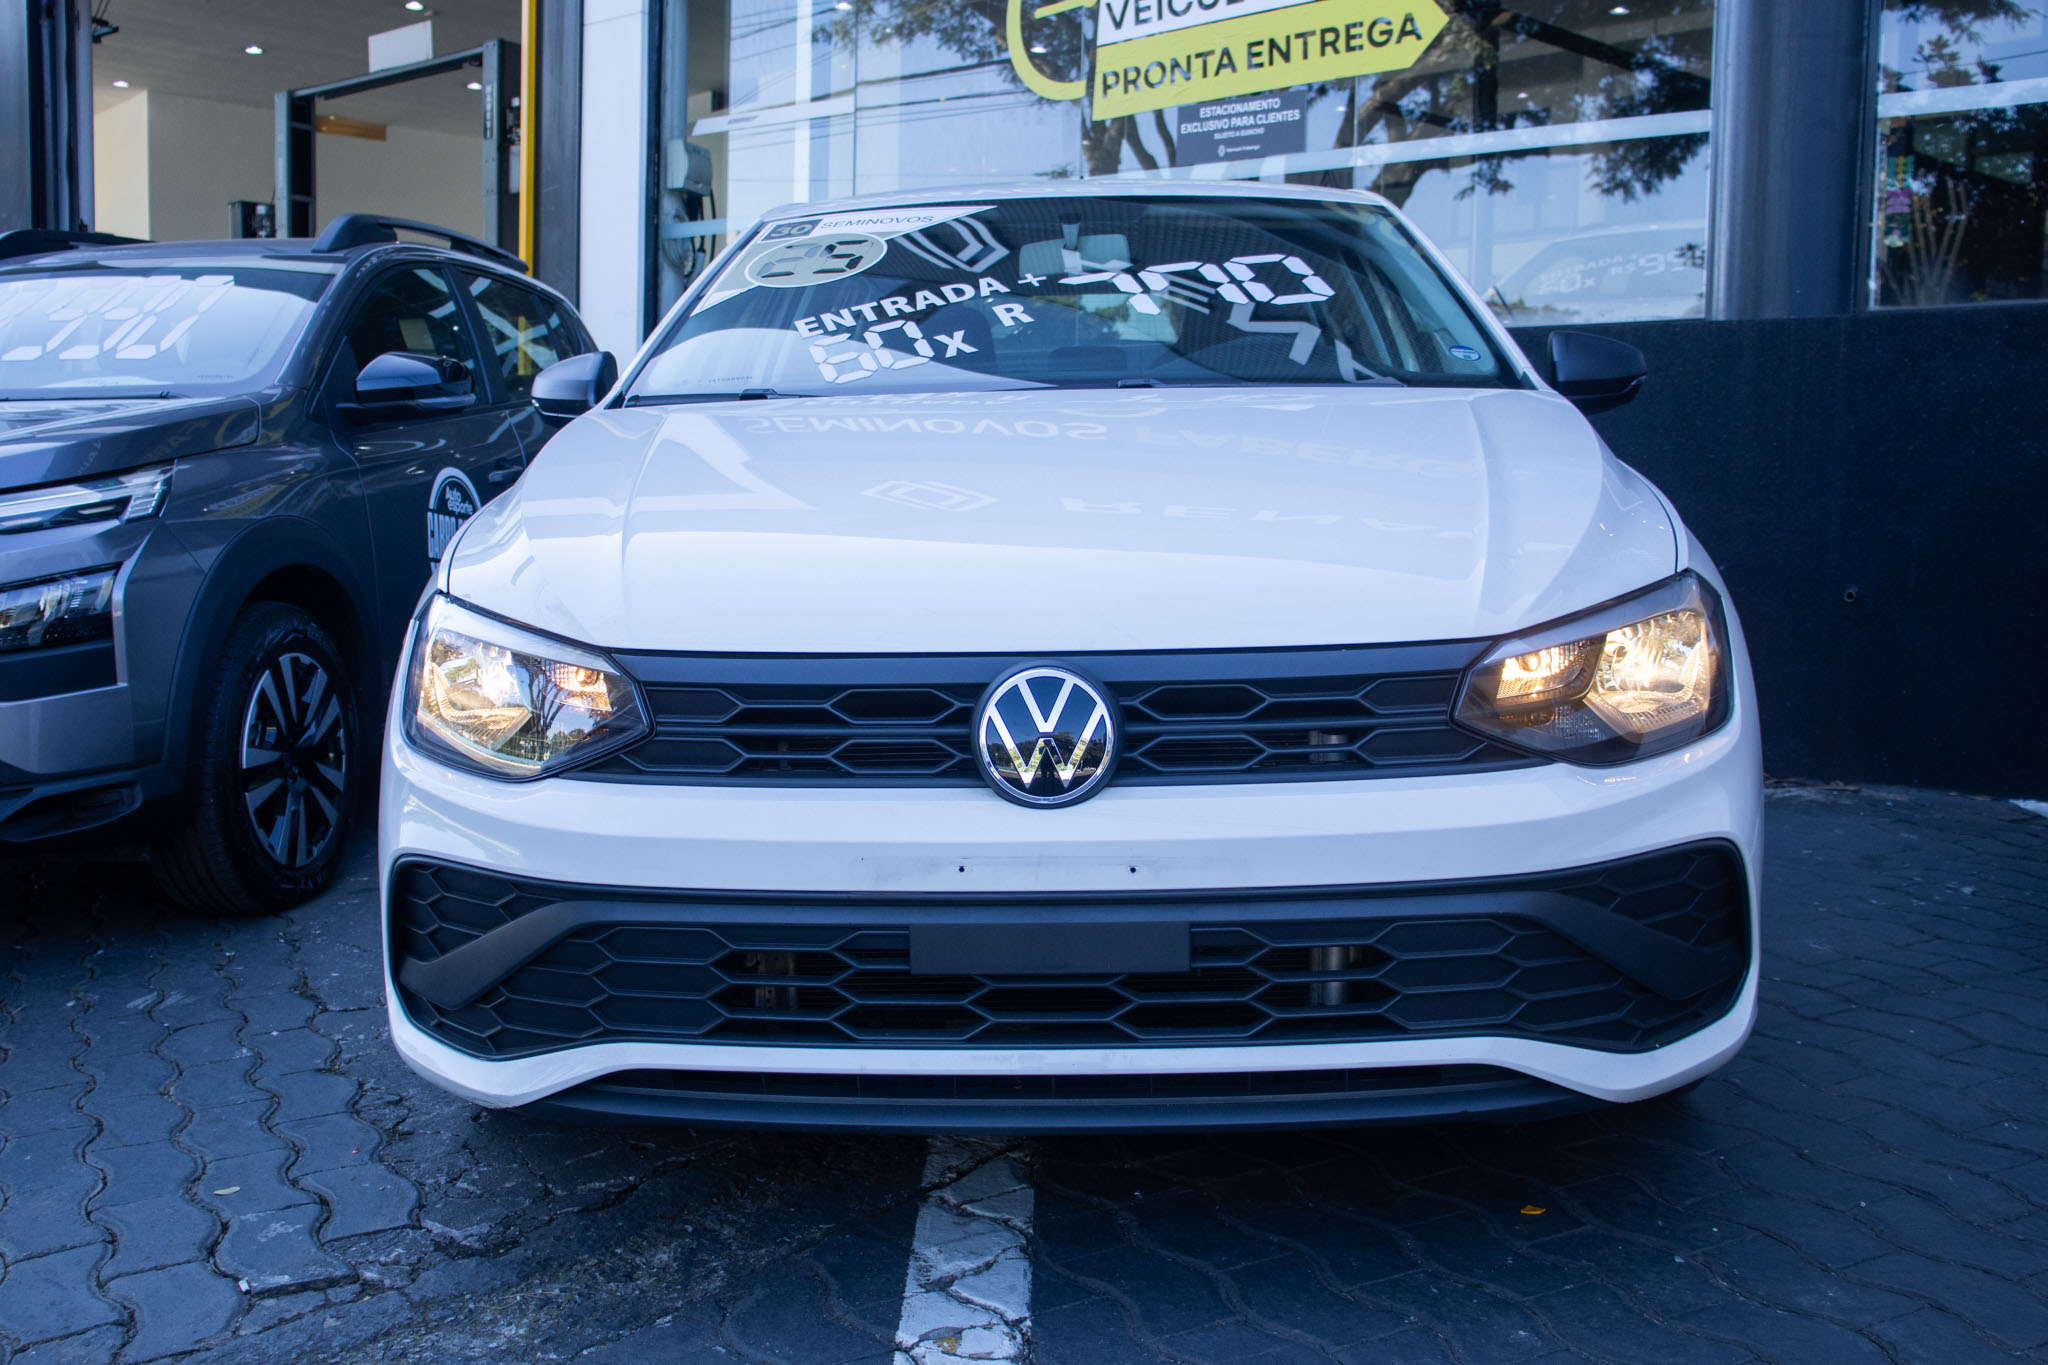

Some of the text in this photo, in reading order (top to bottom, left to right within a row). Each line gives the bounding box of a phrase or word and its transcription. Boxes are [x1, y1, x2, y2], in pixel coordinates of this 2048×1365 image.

[1105, 0, 1247, 31] VEIC
[1102, 12, 1423, 99] PRONTA ENTREGA
[1181, 109, 1301, 135] EXCLUSIVO PARA CLIENTES
[1200, 98, 1281, 118] ESTACIONAMENTO
[820, 215, 935, 229] SEMINOVOS
[794, 277, 1010, 339] ENTRADA
